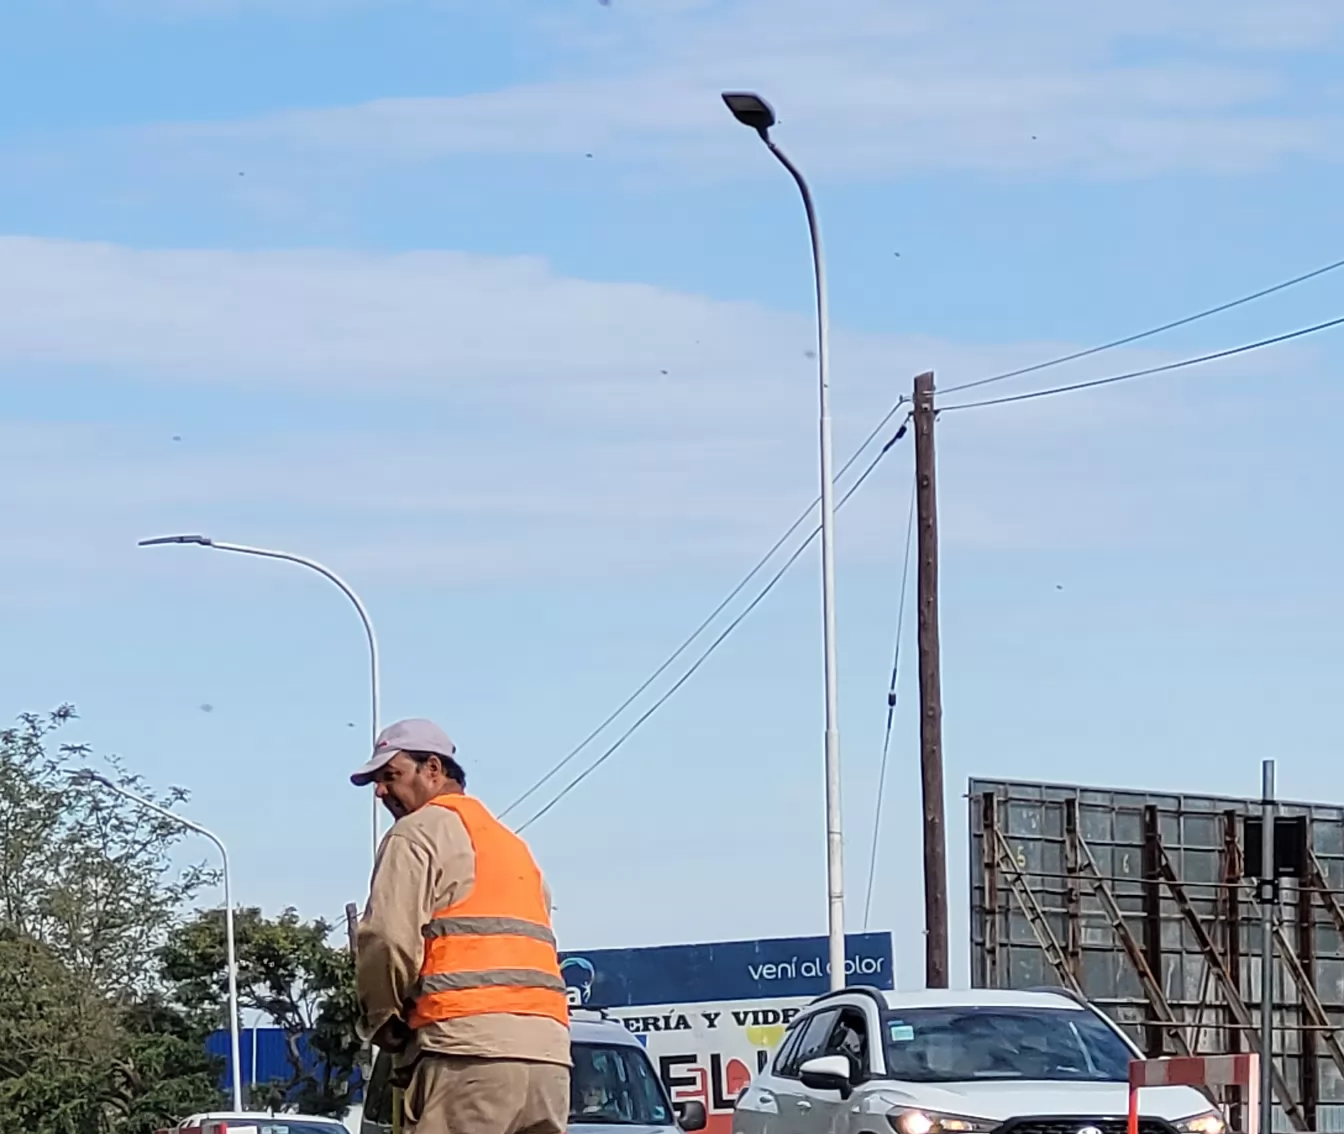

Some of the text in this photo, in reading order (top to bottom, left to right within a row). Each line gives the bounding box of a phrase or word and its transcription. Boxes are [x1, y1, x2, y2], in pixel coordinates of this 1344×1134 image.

[748, 956, 798, 980] vení
[801, 957, 823, 977] al
[620, 1008, 692, 1033] ERÍA
[701, 1012, 721, 1029] Y
